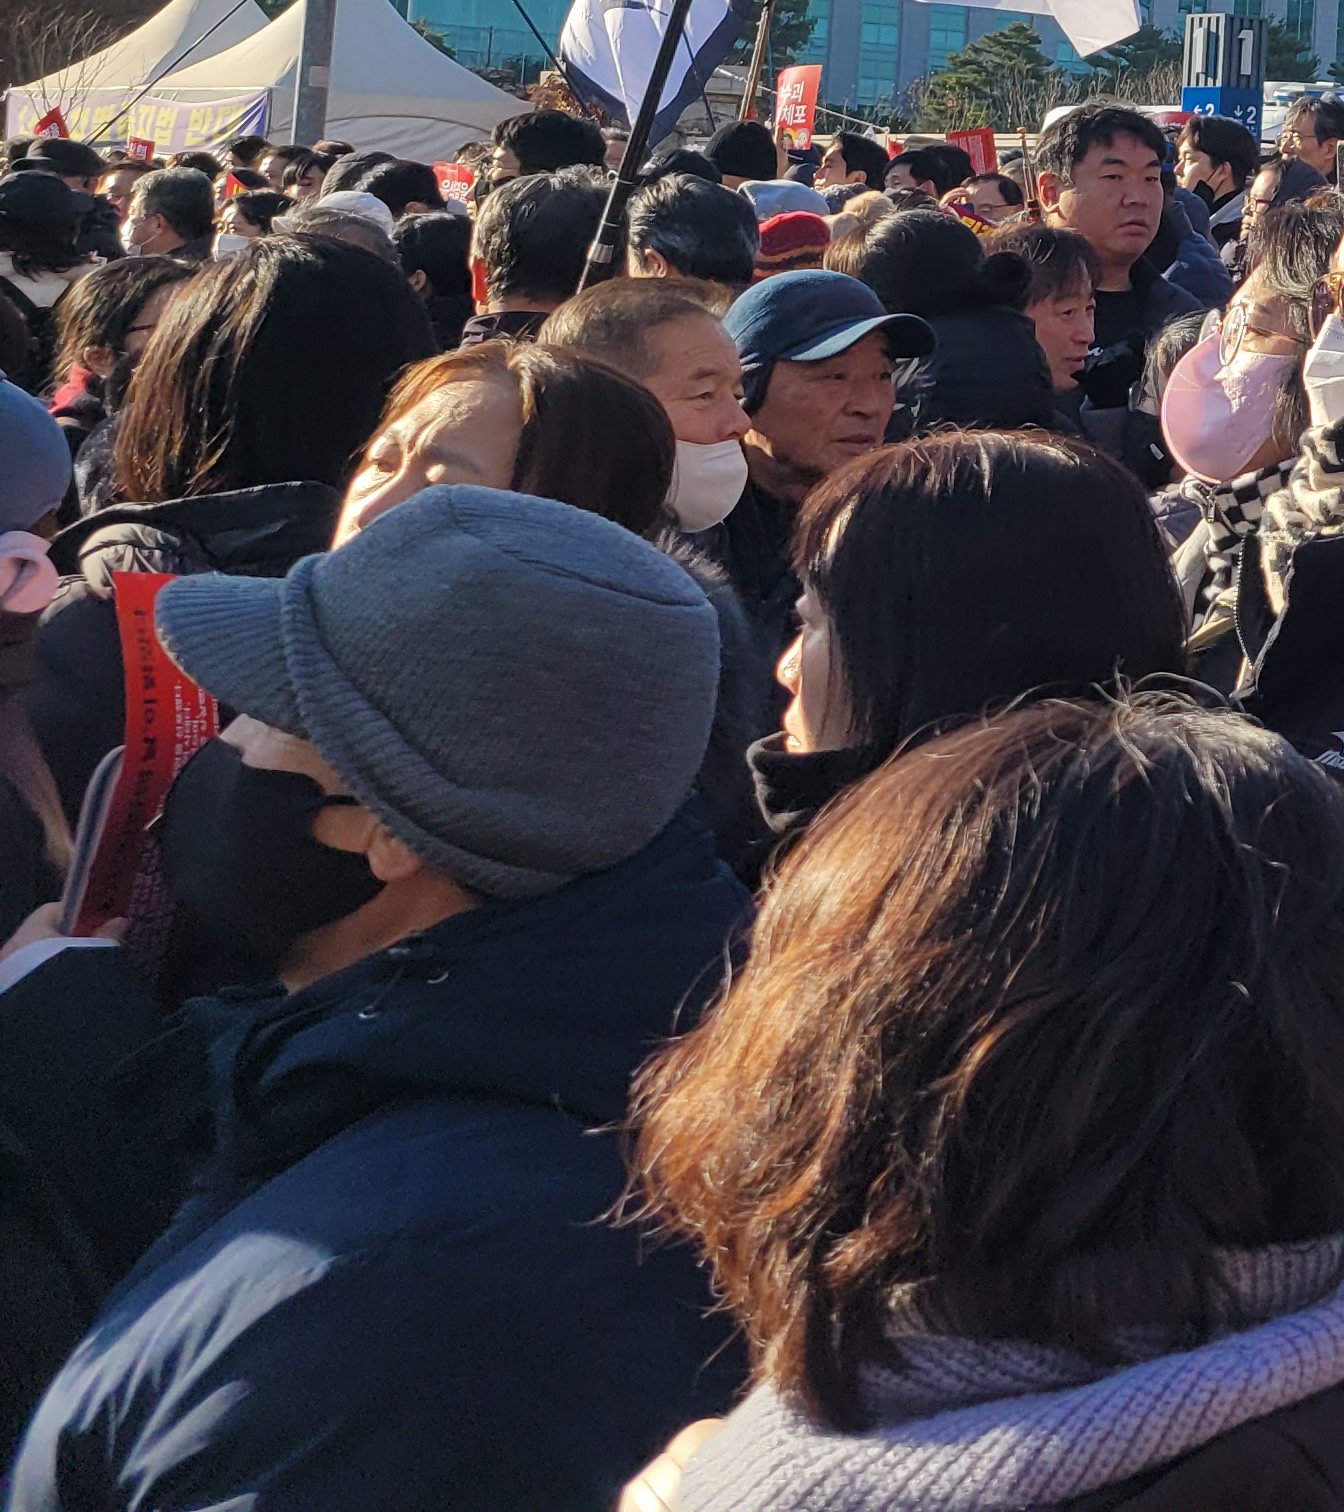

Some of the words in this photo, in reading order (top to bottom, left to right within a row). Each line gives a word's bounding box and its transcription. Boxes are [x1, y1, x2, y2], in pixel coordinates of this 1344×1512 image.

[1238, 29, 1253, 75] 1
[781, 104, 807, 126] 체포
[1246, 106, 1257, 124] 2
